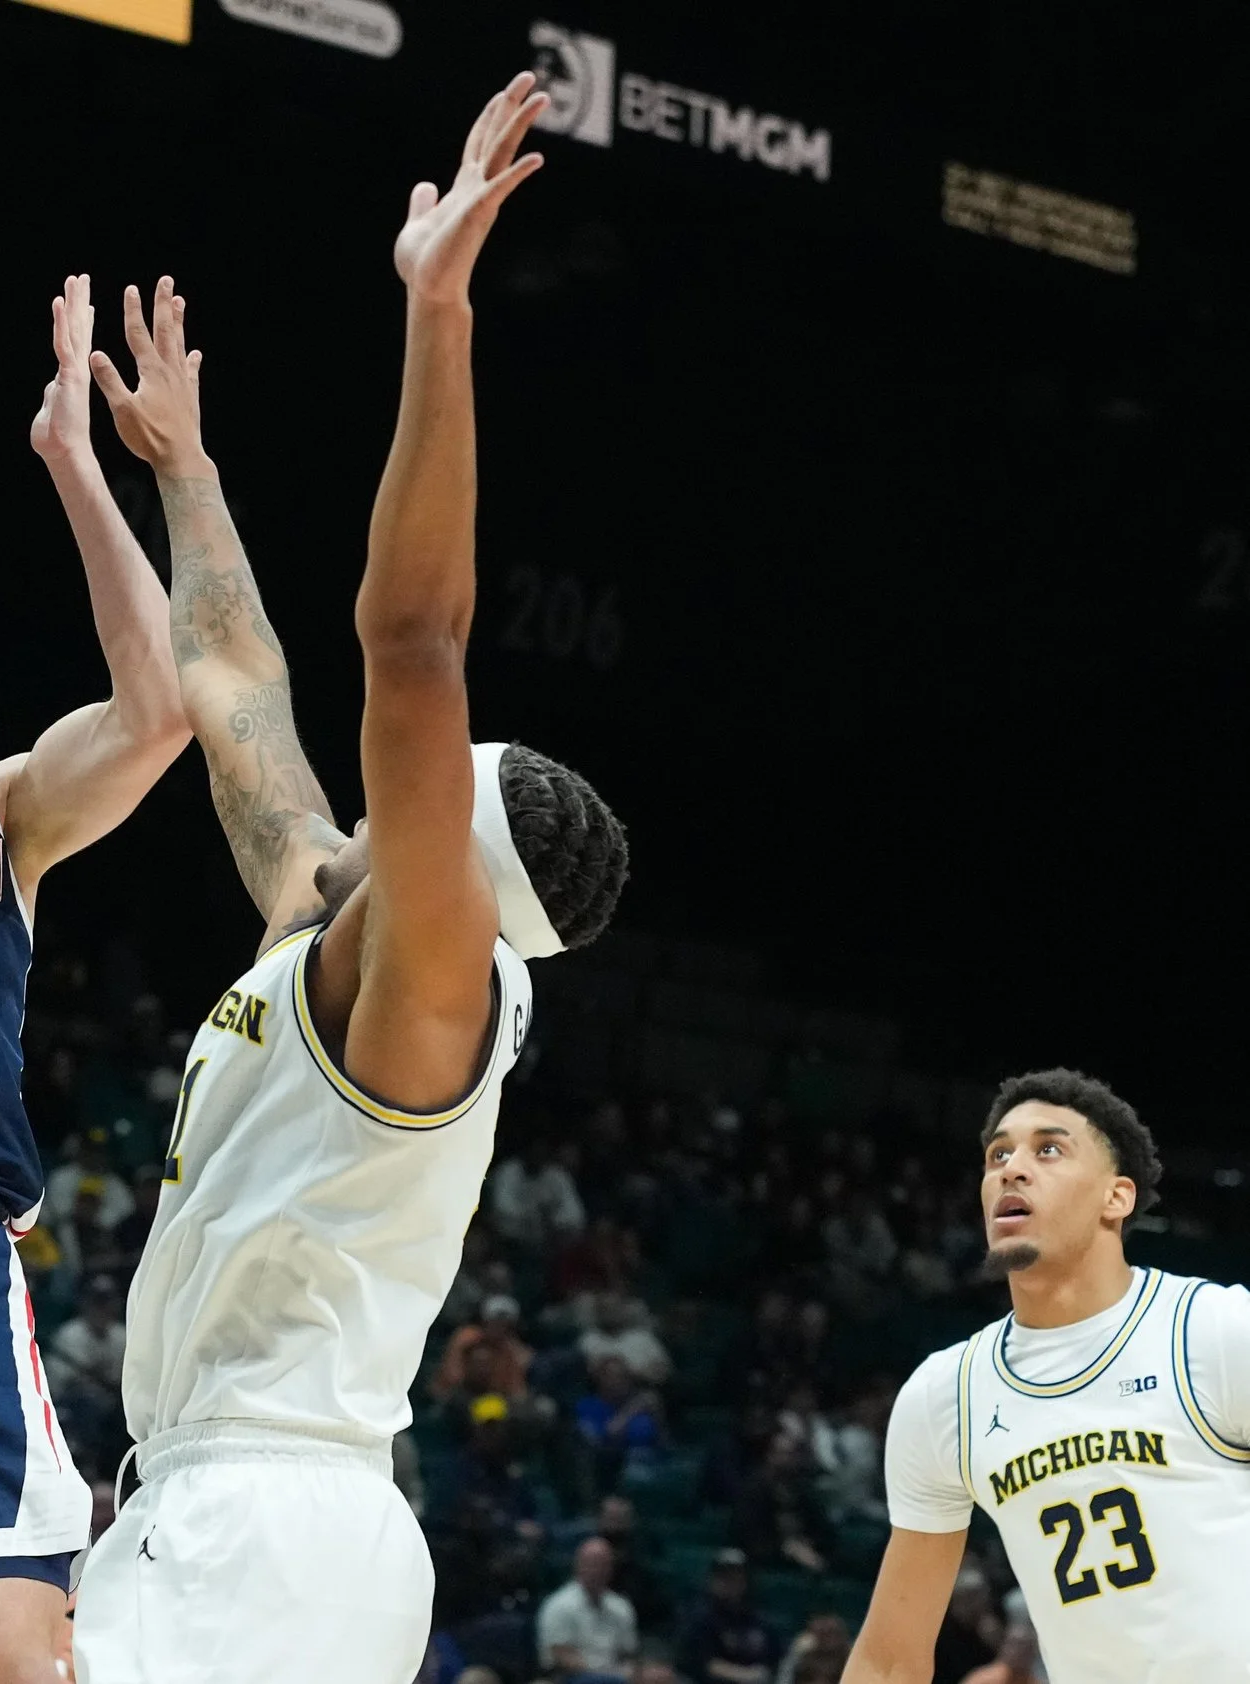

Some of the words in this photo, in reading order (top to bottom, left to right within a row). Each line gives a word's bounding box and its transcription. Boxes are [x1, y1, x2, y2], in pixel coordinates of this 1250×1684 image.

[618, 69, 831, 182] BETMGM
[499, 562, 624, 672] 206
[987, 1428, 1169, 1508] MICHIGAN
[1038, 1486, 1158, 1608] 23
